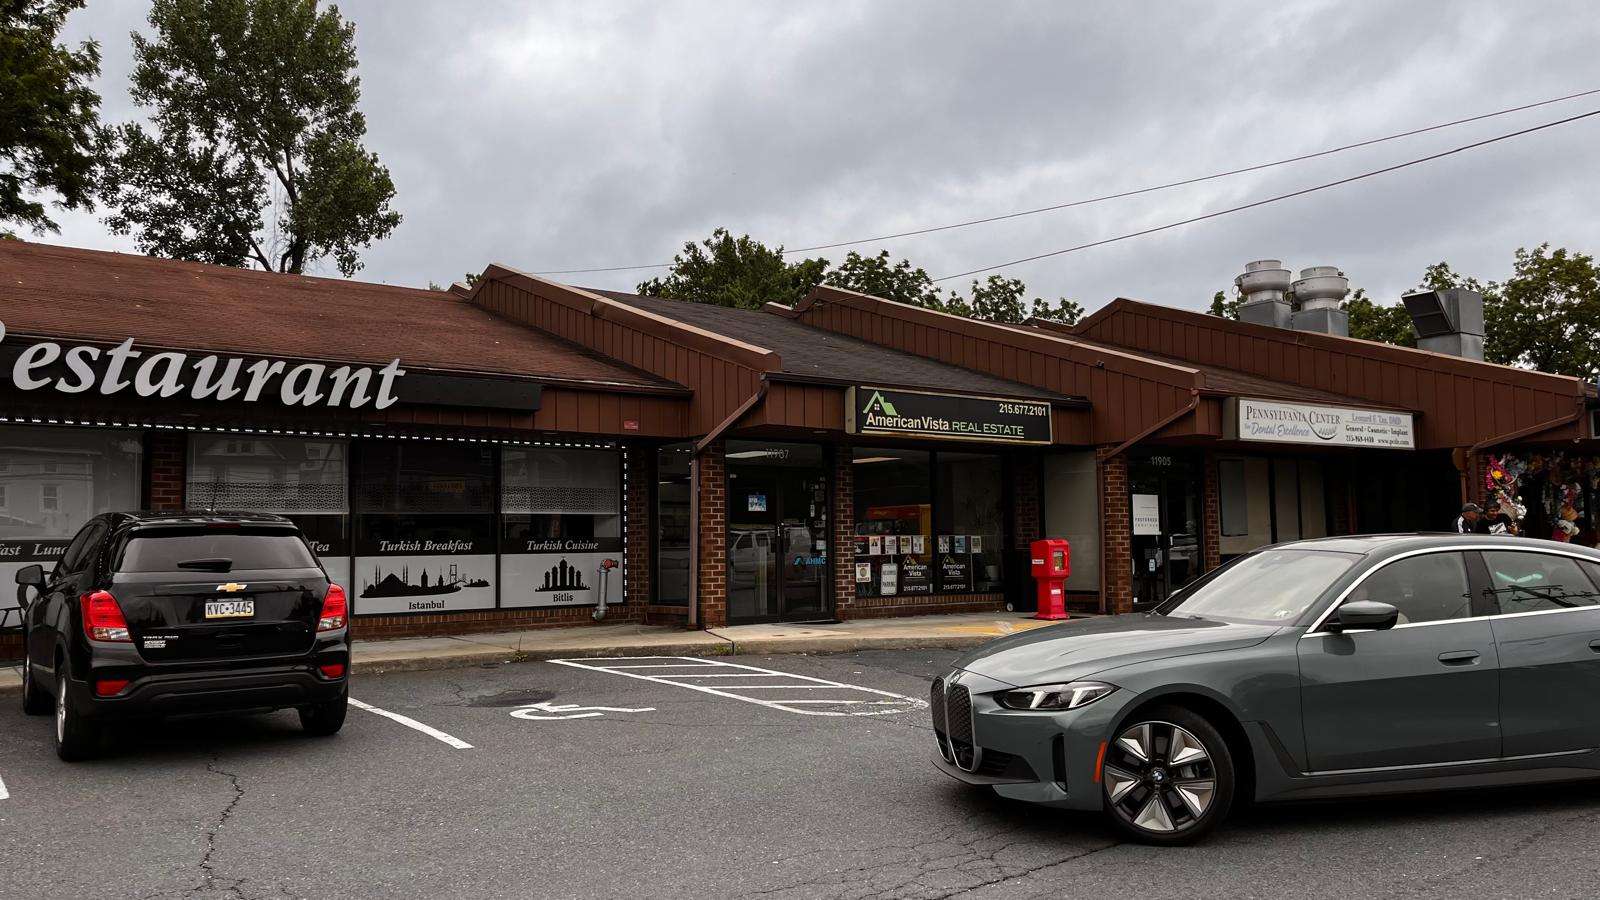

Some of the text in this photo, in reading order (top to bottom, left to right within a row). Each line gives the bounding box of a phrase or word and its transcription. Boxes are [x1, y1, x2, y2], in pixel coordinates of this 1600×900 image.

[0, 320, 406, 411] estaurant
[999, 403, 1047, 417] 215.677.2101
[866, 413, 1025, 435] American Vista REAL ESTATE
[1309, 410, 1341, 426] CENTER
[1250, 422, 1276, 436] Dental
[1277, 424, 1311, 437] Excellence
[1345, 424, 1364, 432] General
[1151, 456, 1172, 466] 11905
[309, 540, 330, 552] Tea
[379, 540, 473, 553] Turkish Breakfast
[527, 540, 599, 551] Turkish Cuisine
[552, 592, 574, 602] Bitlis
[408, 600, 445, 610] Istanbul
